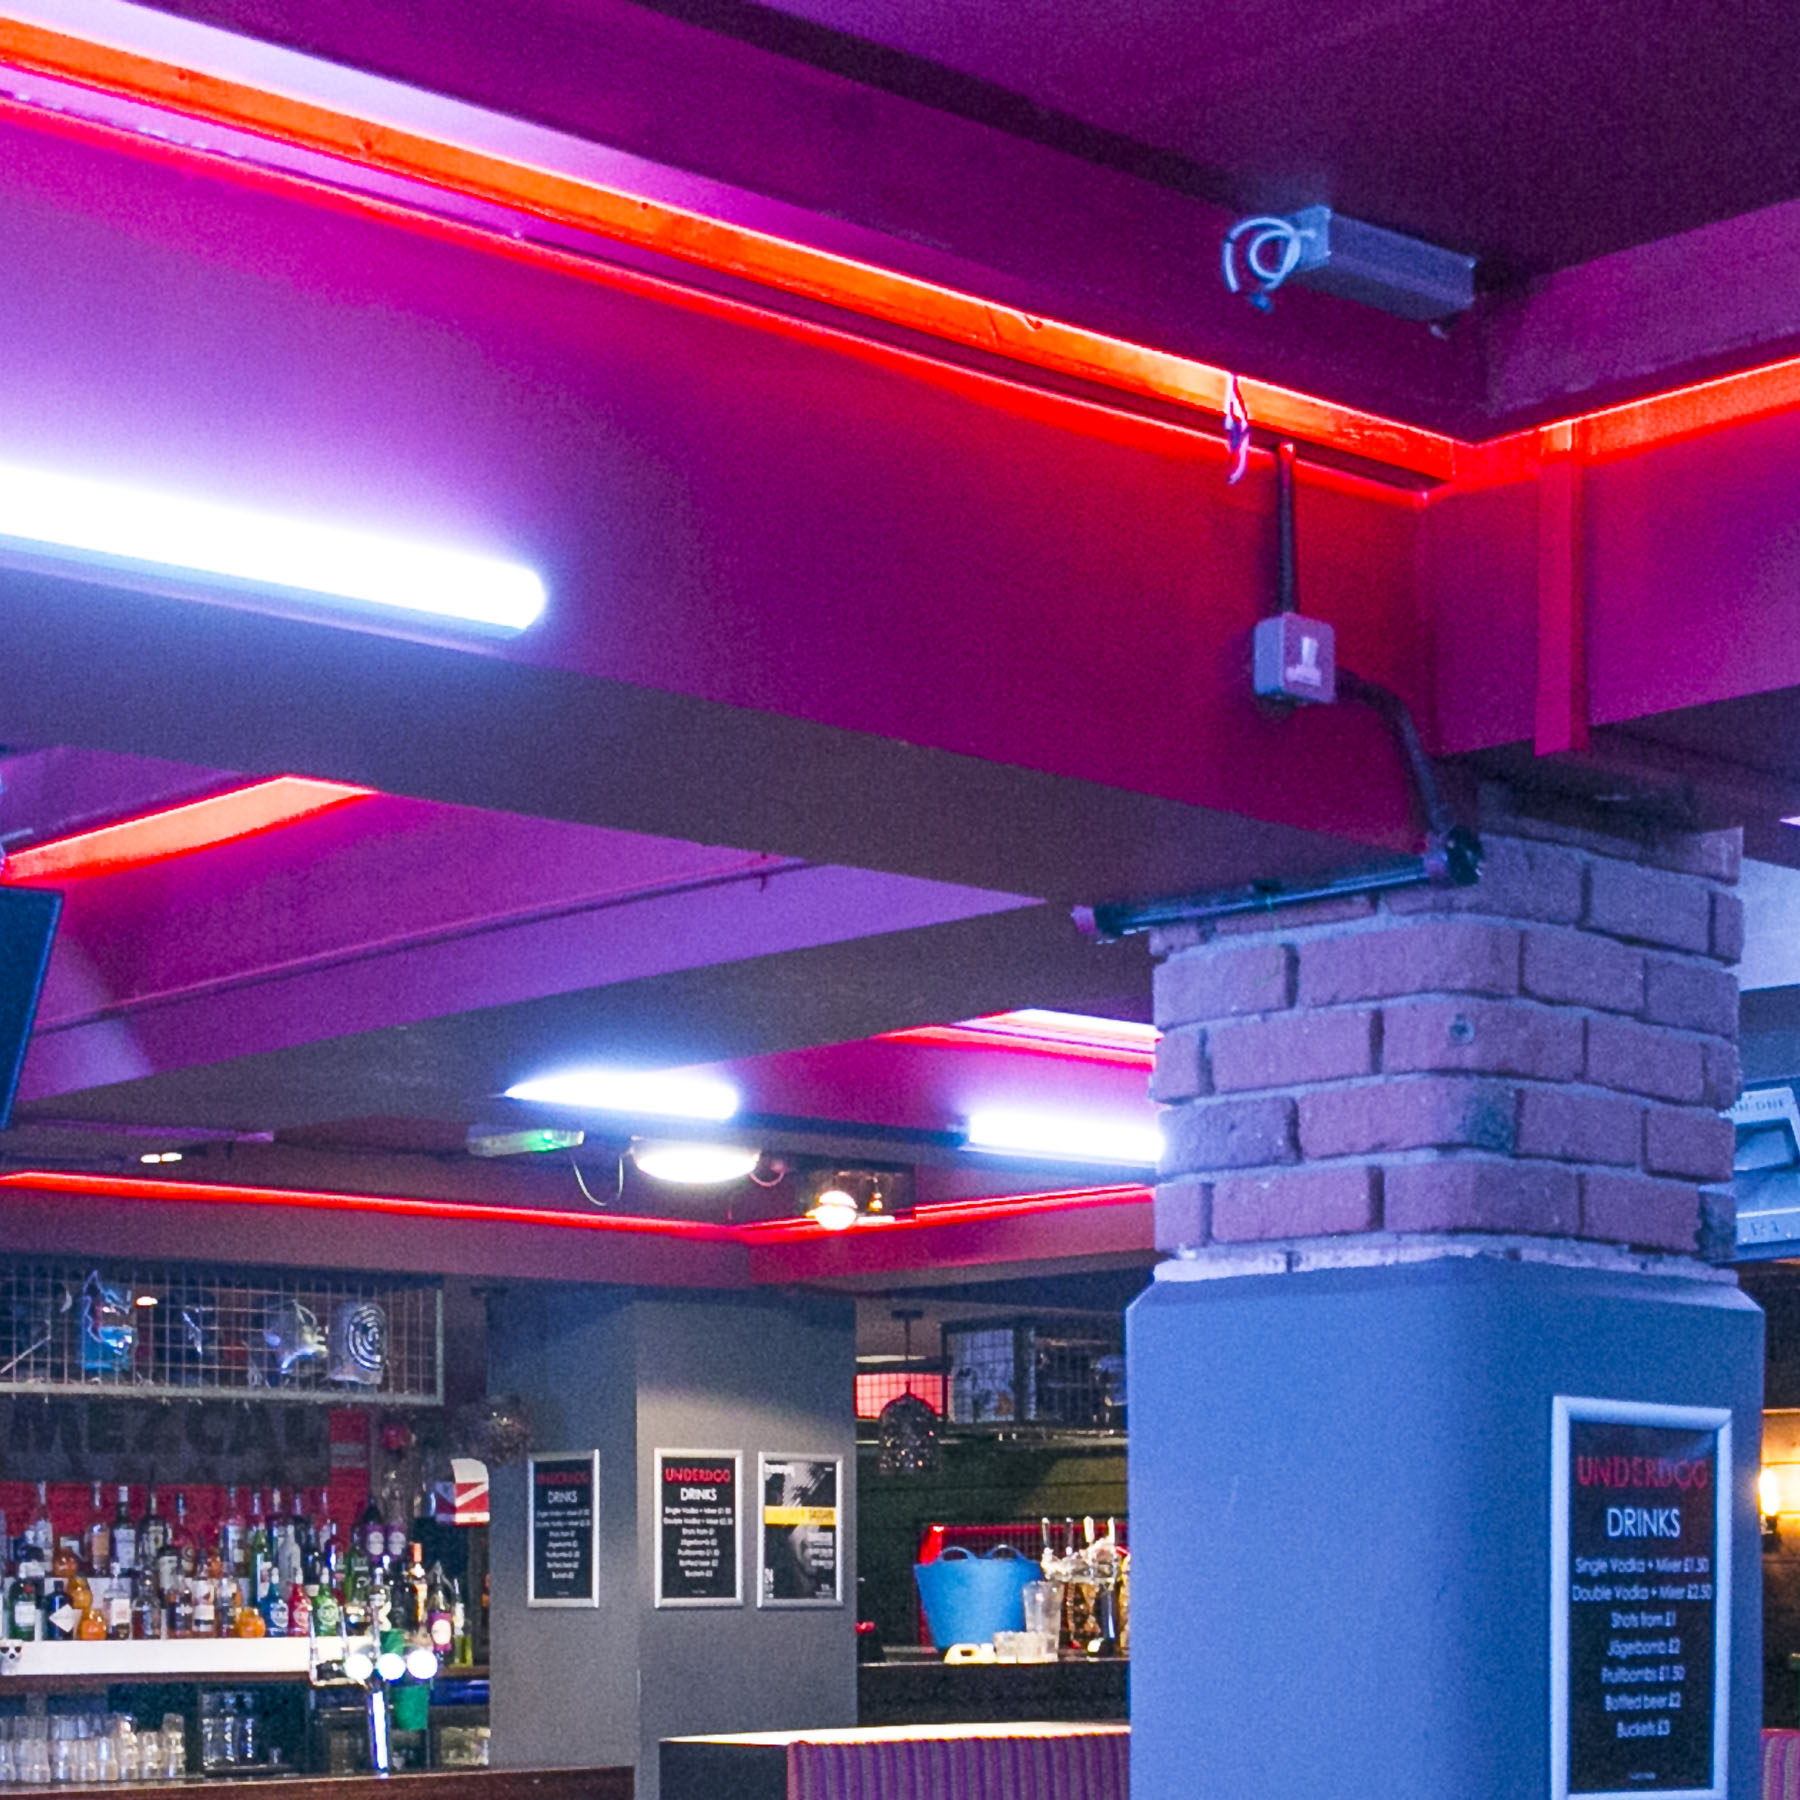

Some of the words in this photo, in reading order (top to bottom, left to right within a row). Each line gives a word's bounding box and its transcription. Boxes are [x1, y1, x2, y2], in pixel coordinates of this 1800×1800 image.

[665, 1468, 731, 1482] UNDERDOG
[1577, 1456, 1708, 1489] UNDERDOG
[680, 1488, 718, 1501] DRINKS
[1607, 1508, 1681, 1538] DRINKS
[1576, 1557, 1608, 1577] Single
[1610, 1557, 1645, 1573] Vodka
[1656, 1558, 1682, 1573] Mixer
[1683, 1557, 1709, 1573] £1.50
[1572, 1584, 1612, 1601] Double
[1613, 1584, 1648, 1600] Vodka
[1659, 1585, 1685, 1600] Mixer
[1687, 1583, 1712, 1600] £2.50
[1611, 1611, 1639, 1629] Shots
[1640, 1611, 1663, 1628] from
[1665, 1610, 1677, 1627] £1
[1668, 1637, 1681, 1654] £2
[1601, 1666, 1658, 1683] Fruitbombs
[1659, 1665, 1686, 1682] £1.50
[1605, 1694, 1642, 1711] Bottled
[1643, 1694, 1667, 1710] beer
[1668, 1691, 1682, 1708] £2
[1617, 1720, 1656, 1738] Buckets
[1657, 1719, 1670, 1736] £3
